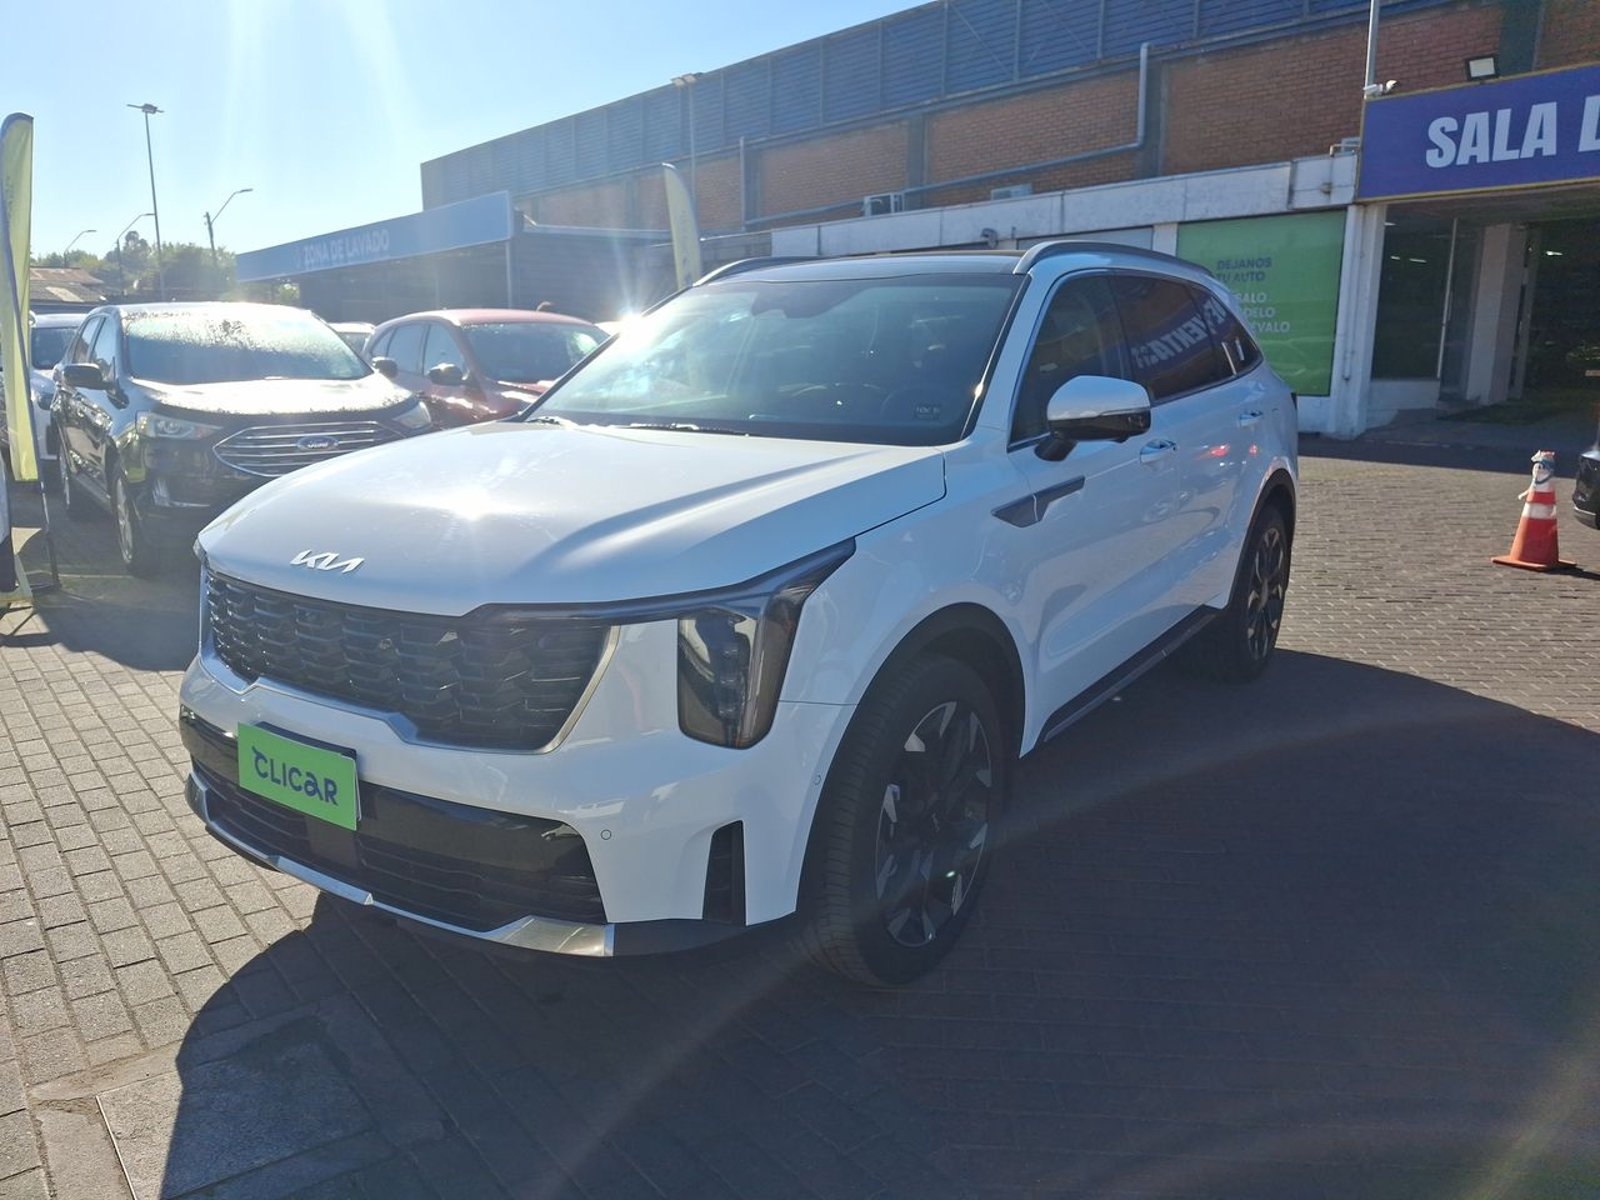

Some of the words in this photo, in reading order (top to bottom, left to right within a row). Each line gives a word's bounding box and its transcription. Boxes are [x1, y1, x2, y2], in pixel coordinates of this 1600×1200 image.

[1425, 101, 1557, 169] SALA
[304, 241, 330, 266] ZONA
[330, 238, 345, 260] DE
[346, 228, 390, 258] LAVADO
[1217, 257, 1272, 270] DEJANOS
[1235, 270, 1266, 282] AUTO
